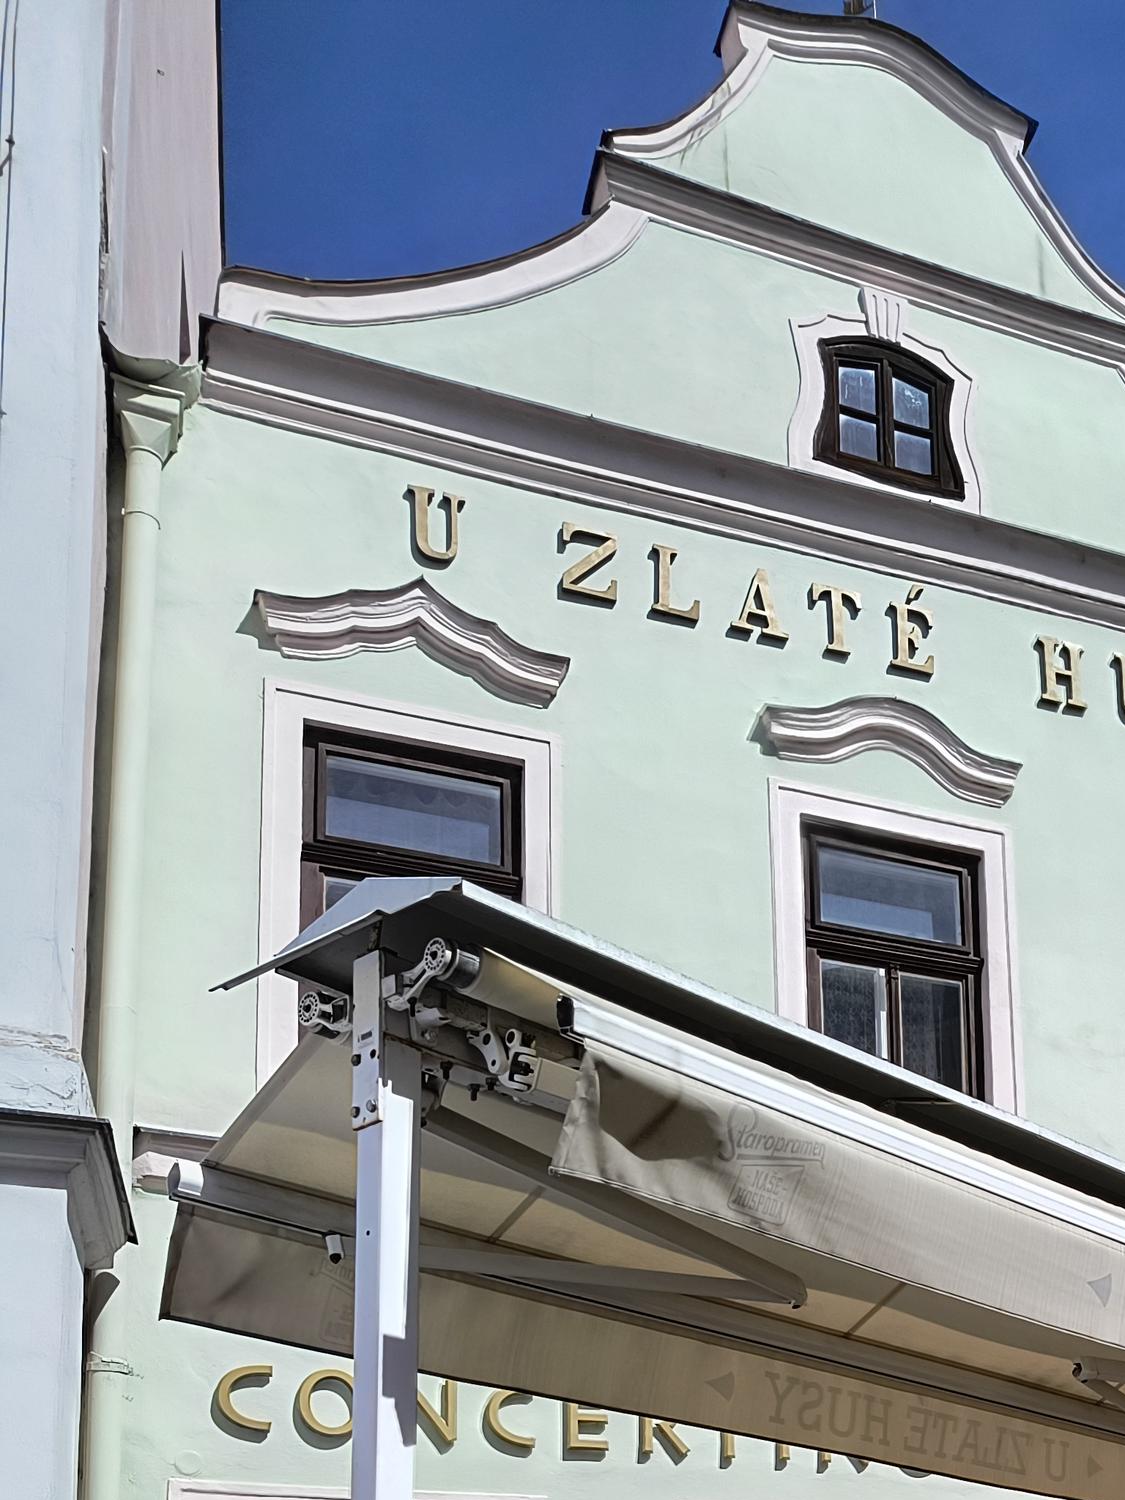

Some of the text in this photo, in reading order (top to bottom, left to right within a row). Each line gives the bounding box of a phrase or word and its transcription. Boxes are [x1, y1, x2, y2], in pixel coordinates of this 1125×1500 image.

[407, 484, 465, 565] U
[558, 522, 937, 679] ZLATÉ
[718, 1103, 827, 1170] Staropramen
